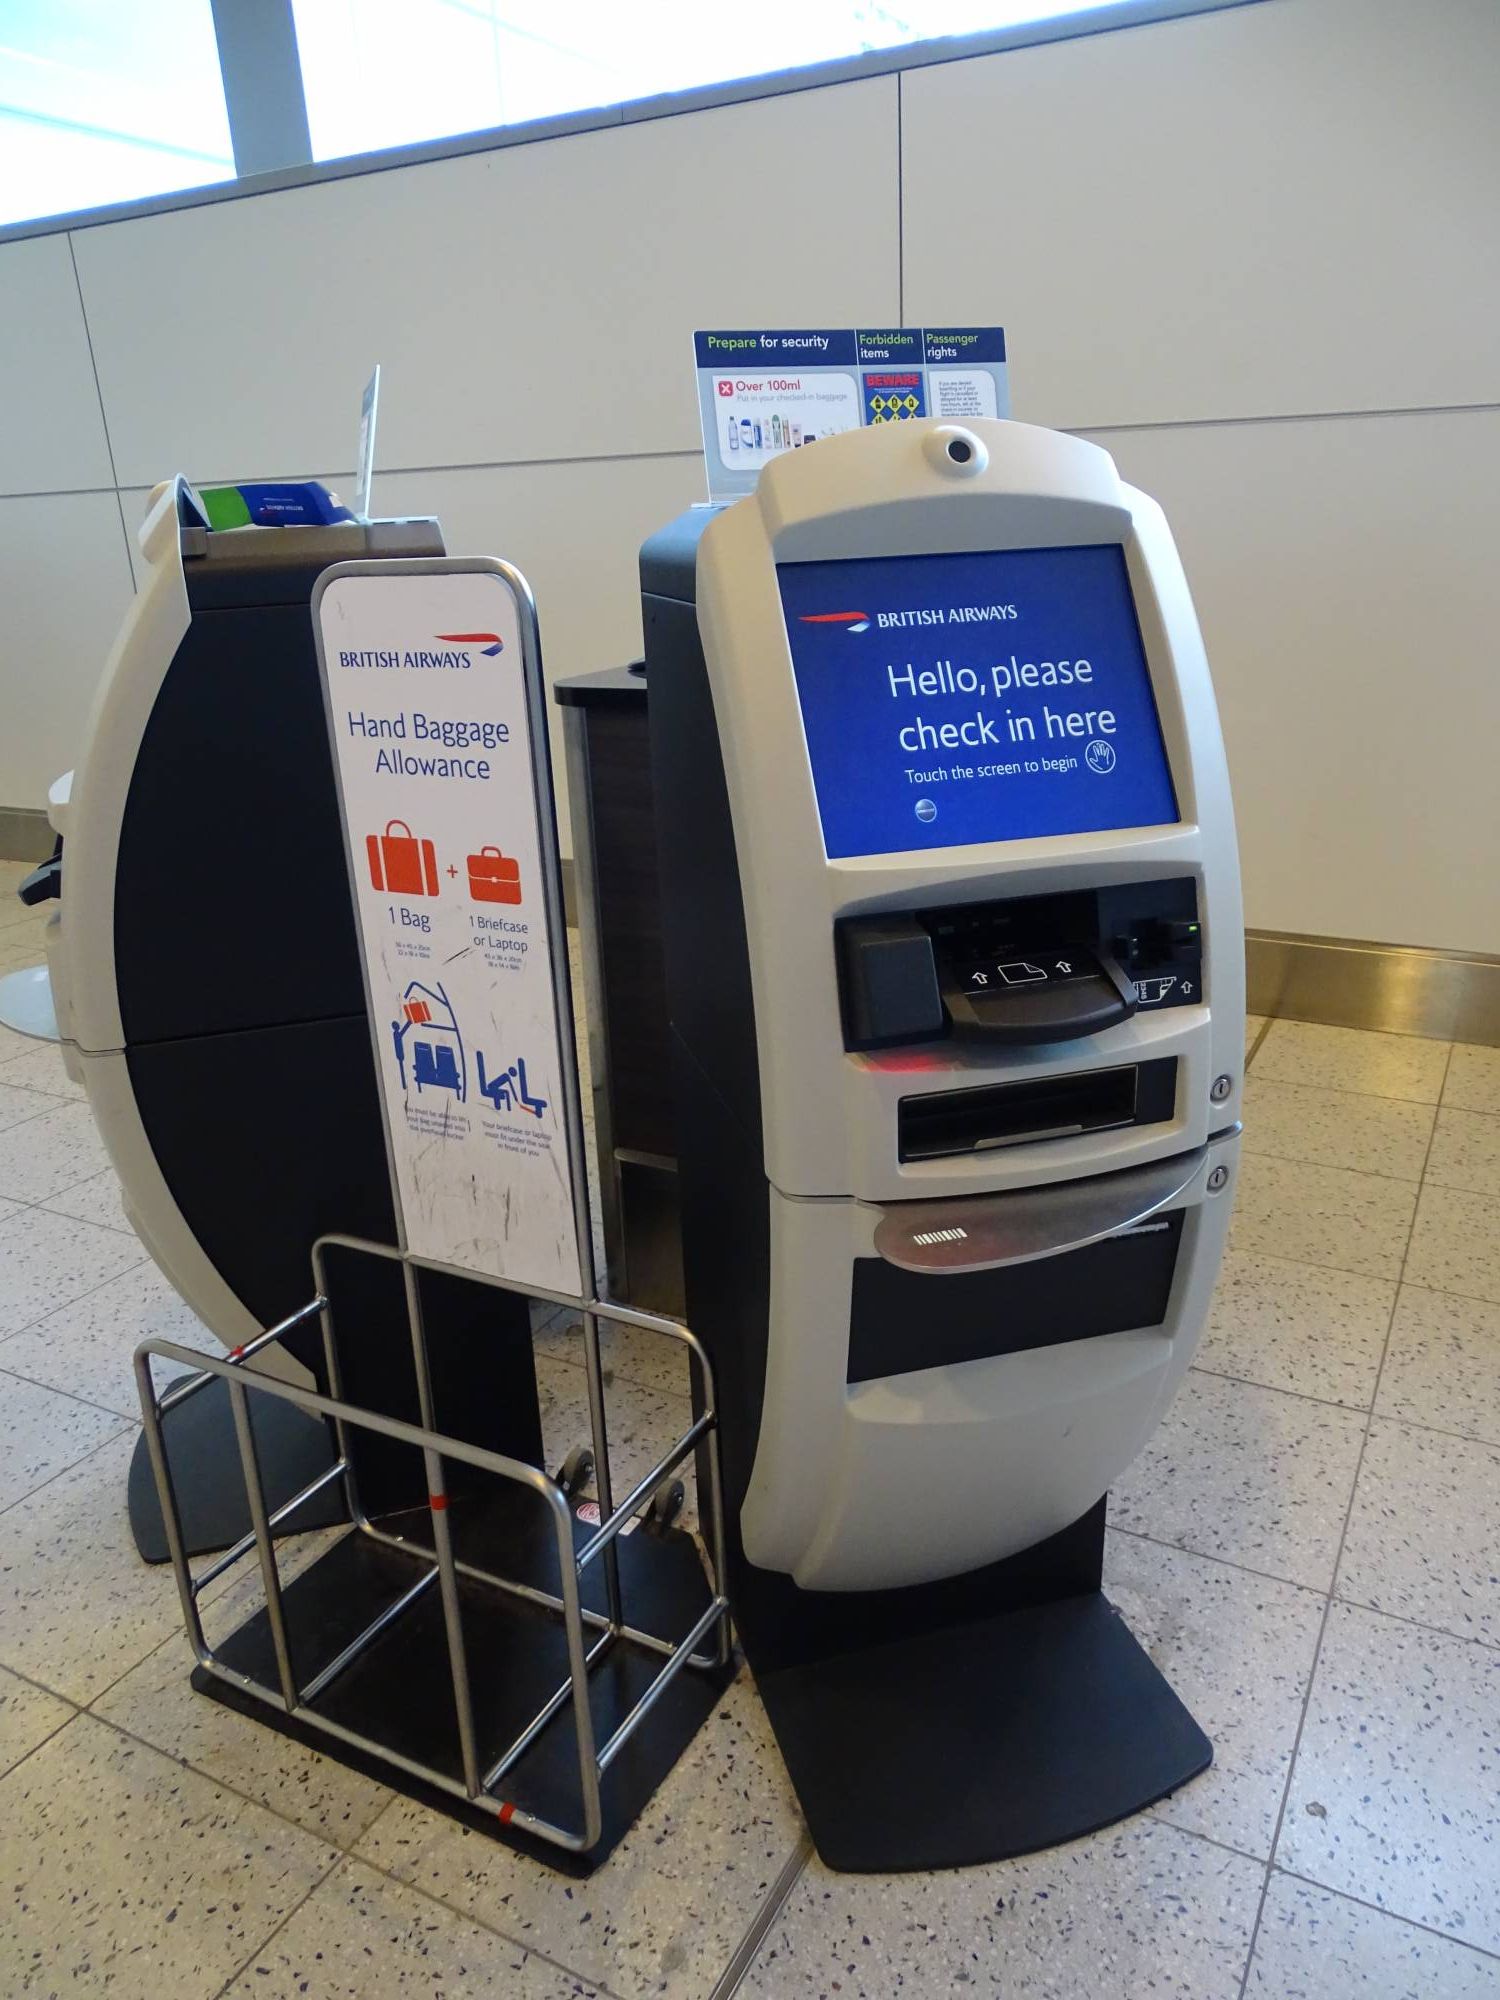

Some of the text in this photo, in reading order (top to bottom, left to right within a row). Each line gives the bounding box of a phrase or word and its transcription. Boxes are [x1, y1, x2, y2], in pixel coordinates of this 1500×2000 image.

[708, 335, 829, 351] Prepare for security
[859, 334, 914, 345] Forbidden
[926, 333, 979, 345] Passenger
[860, 348, 890, 358] items
[927, 346, 957, 359] rights
[736, 379, 801, 391] Over 100ml
[866, 374, 919, 387] BEWARE
[878, 604, 1018, 628] BRITISH AIRWAYS
[339, 651, 471, 669] BRITISH AIRWAYS
[887, 655, 1093, 698] Hello, please
[348, 711, 509, 749] Hand Baggage
[899, 706, 1117, 752] check in here
[375, 748, 490, 779] Allowance
[905, 756, 1078, 784] Touch the screen to begin
[388, 907, 431, 933] 1 Bag
[469, 915, 529, 934] 1 Briefcase
[473, 934, 529, 953] or Laptop
